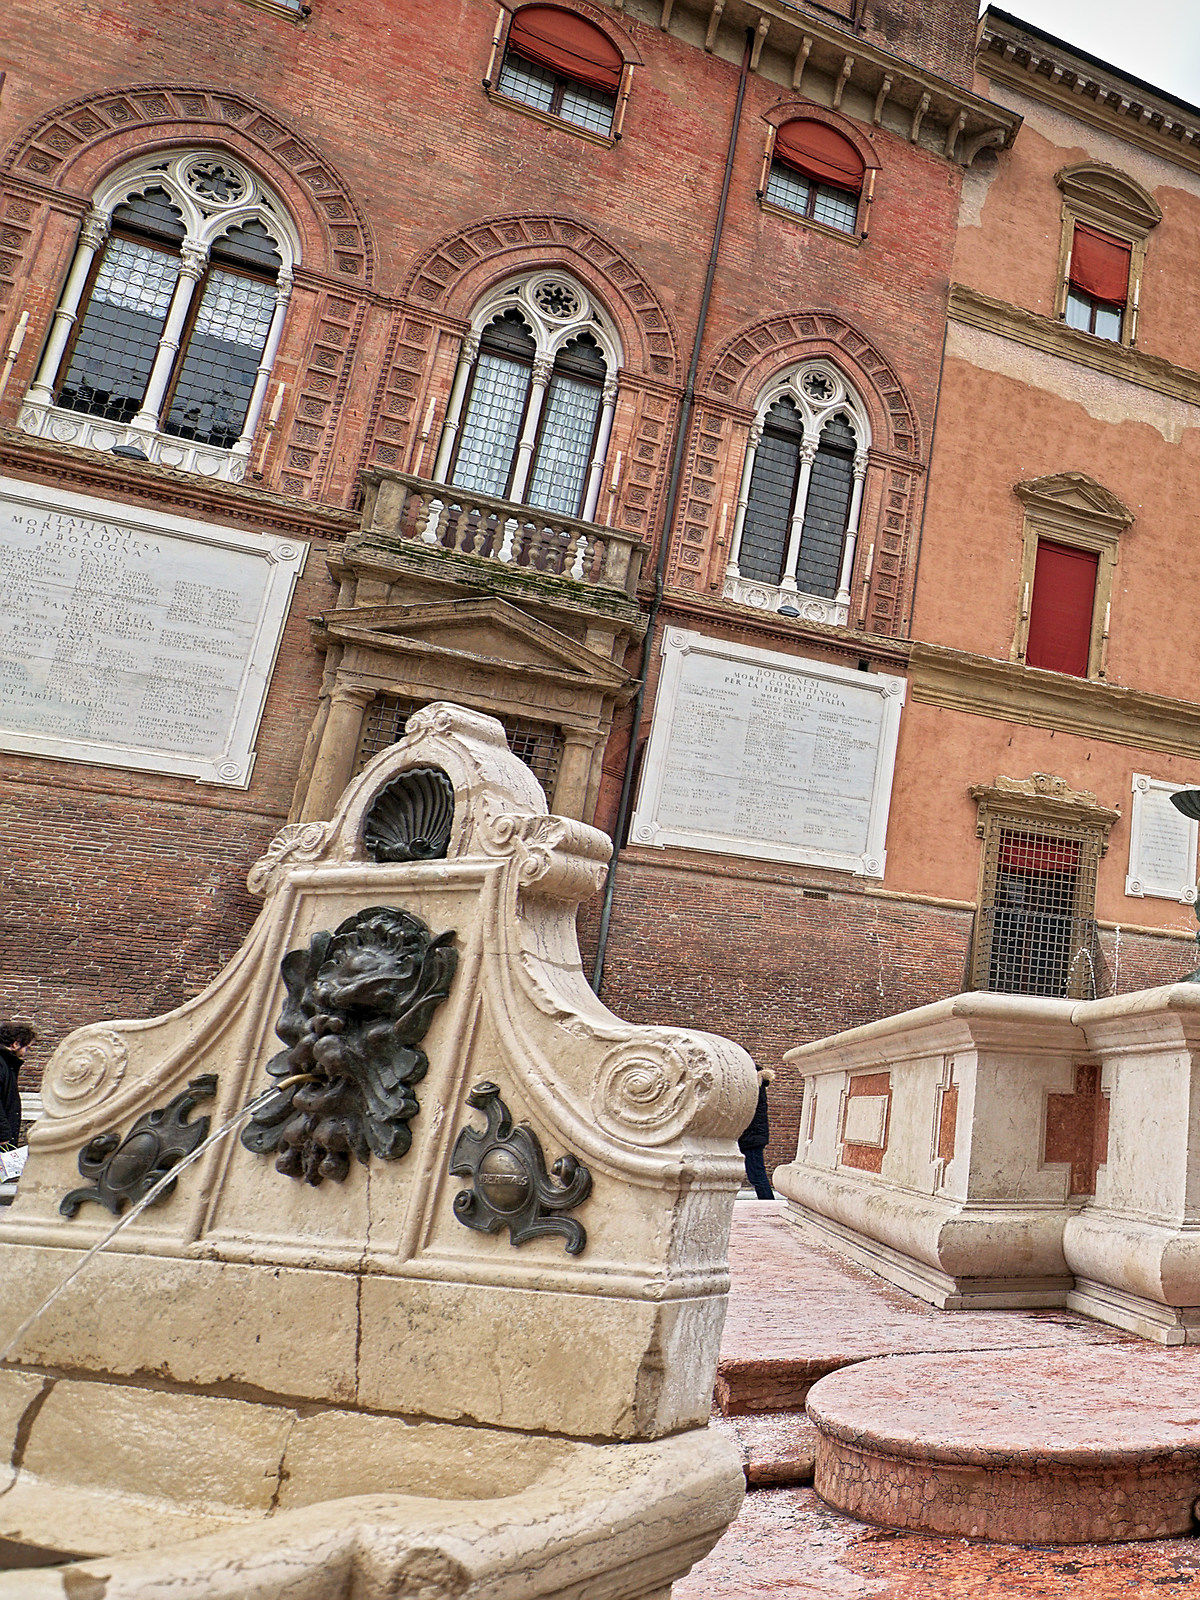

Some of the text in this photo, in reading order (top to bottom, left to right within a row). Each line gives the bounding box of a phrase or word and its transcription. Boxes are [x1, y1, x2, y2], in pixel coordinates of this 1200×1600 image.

[11, 514, 162, 553] MORTI A DIFESA
[46, 512, 133, 539] ITALIANI
[24, 525, 143, 557] DI BOLOGNA
[34, 544, 126, 568] BOLOGNESI
[42, 599, 84, 613] PARTI
[12, 624, 101, 645] BOLOGNESI
[723, 676, 742, 685] PER
[747, 681, 759, 689] LA
[816, 695, 846, 707] ITALIA
[733, 671, 839, 700] MORTI COMBATTENDO
[756, 667, 819, 689] BOLOGNESI
